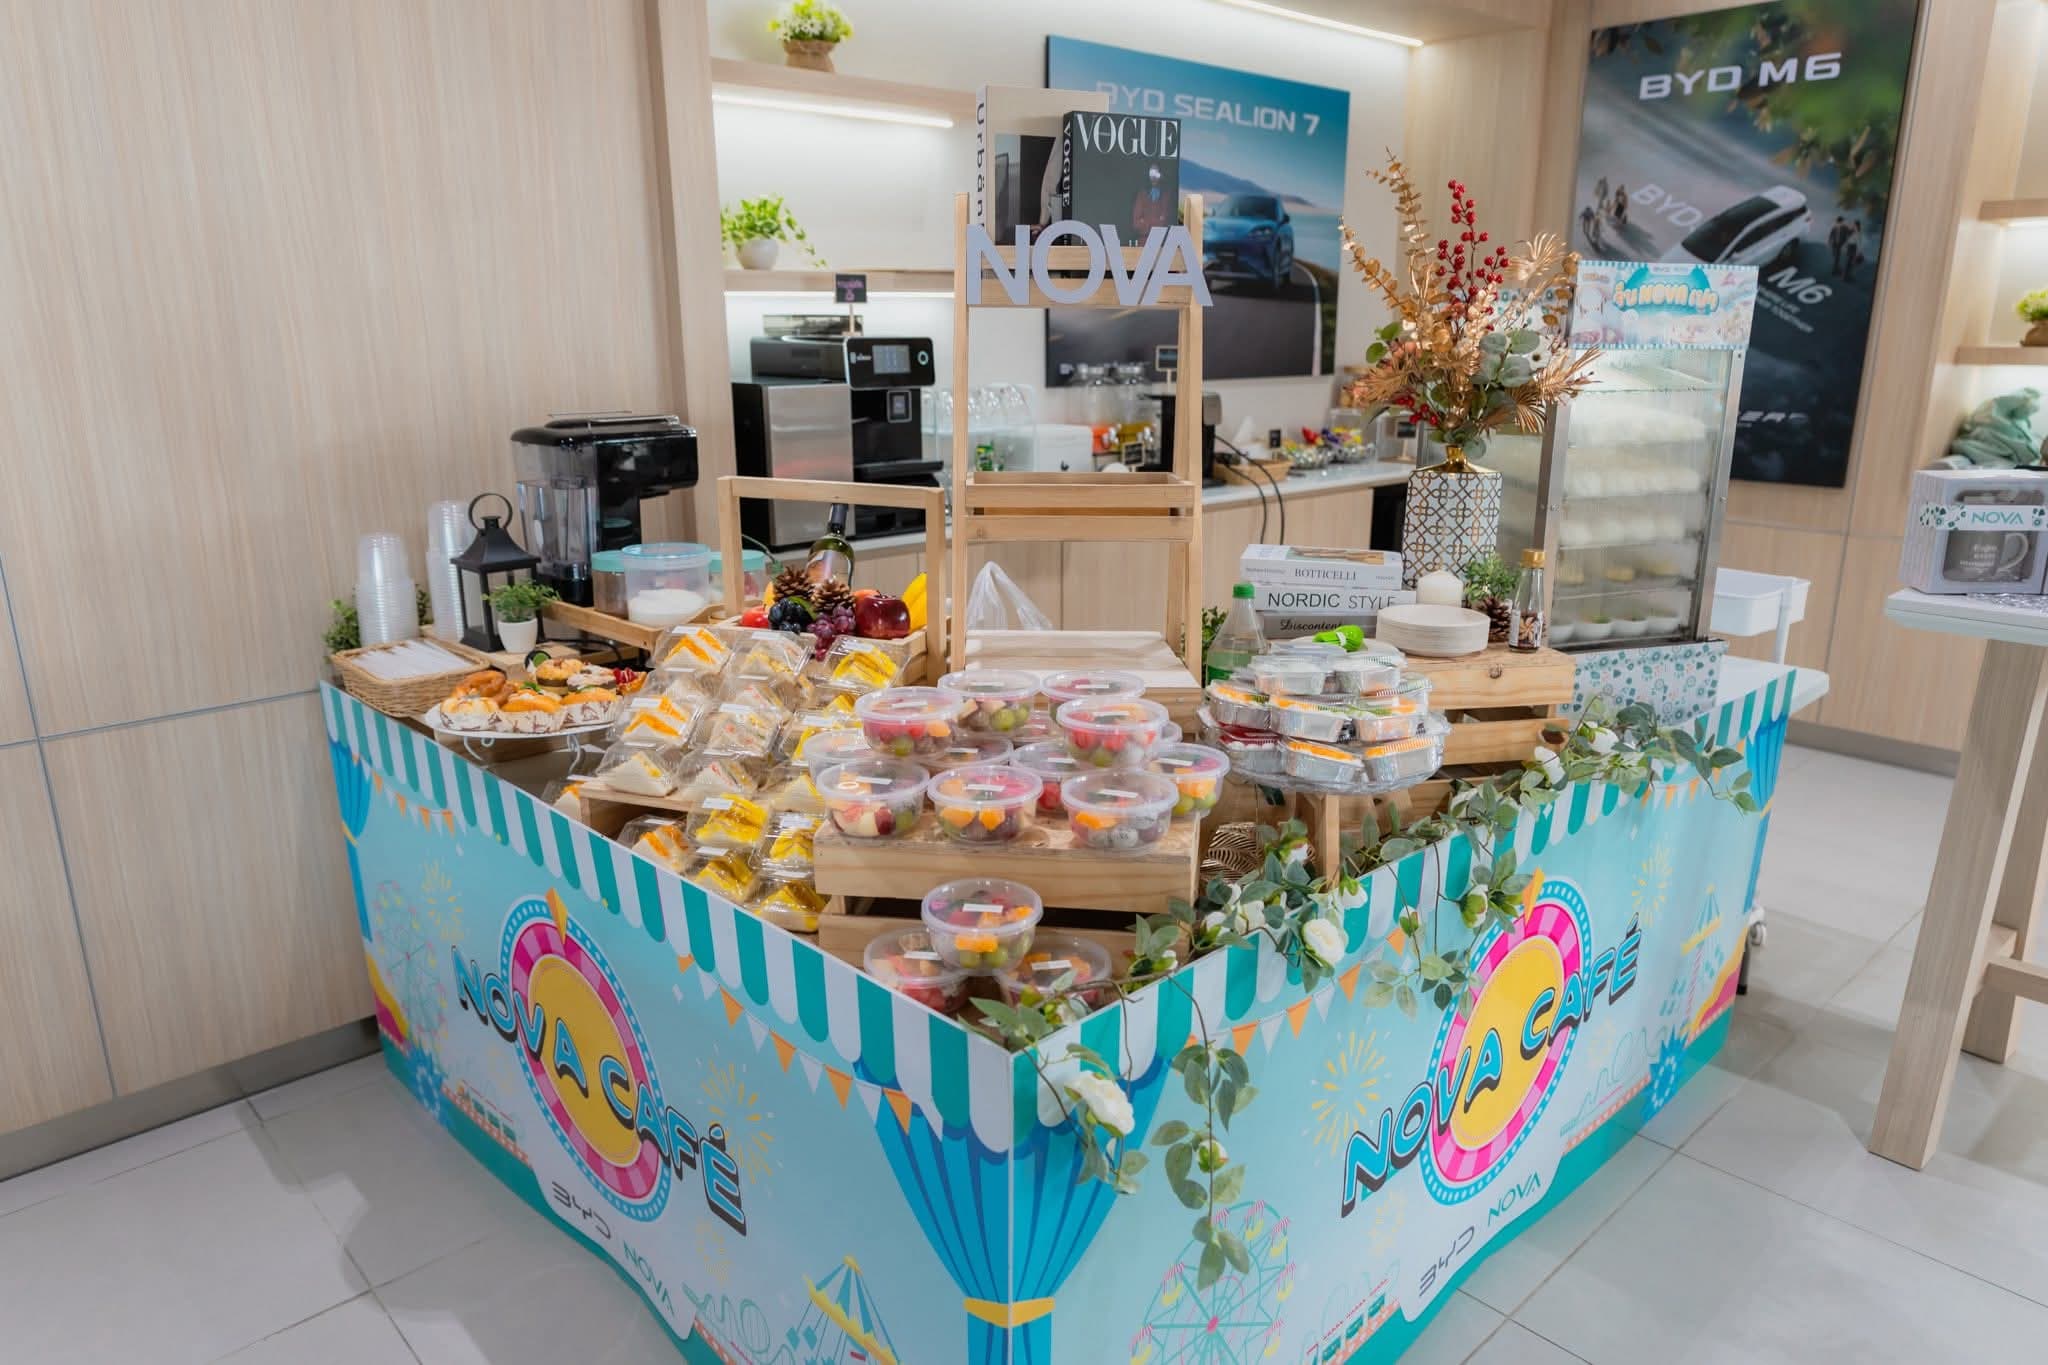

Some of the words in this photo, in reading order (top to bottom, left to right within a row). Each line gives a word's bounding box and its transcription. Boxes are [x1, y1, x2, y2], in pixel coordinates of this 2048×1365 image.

[1639, 63, 1743, 100] BYD
[1758, 51, 1842, 88] M6
[1075, 113, 1178, 158] VOGUE
[1173, 92, 1297, 134] SEALION
[1302, 113, 1321, 137] 7
[1062, 120, 1072, 208] VOGUE
[1631, 183, 1704, 229] BYD
[966, 219, 1213, 306] NOVA
[1767, 265, 1833, 304] M6
[1971, 511, 2024, 525] NOVA
[1268, 593, 1340, 608] NORDIC
[1294, 568, 1356, 581] BOTTICELLI
[452, 945, 590, 1098] NOVA
[600, 1055, 748, 1236] CAFÉ
[1341, 1027, 1504, 1220] NOVA
[1520, 912, 1642, 1060] CAFÉ
[551, 1181, 612, 1240] BYD
[1486, 1171, 1542, 1227] NOVA
[623, 1240, 676, 1315] NOVA
[1418, 1226, 1476, 1298] BYD
